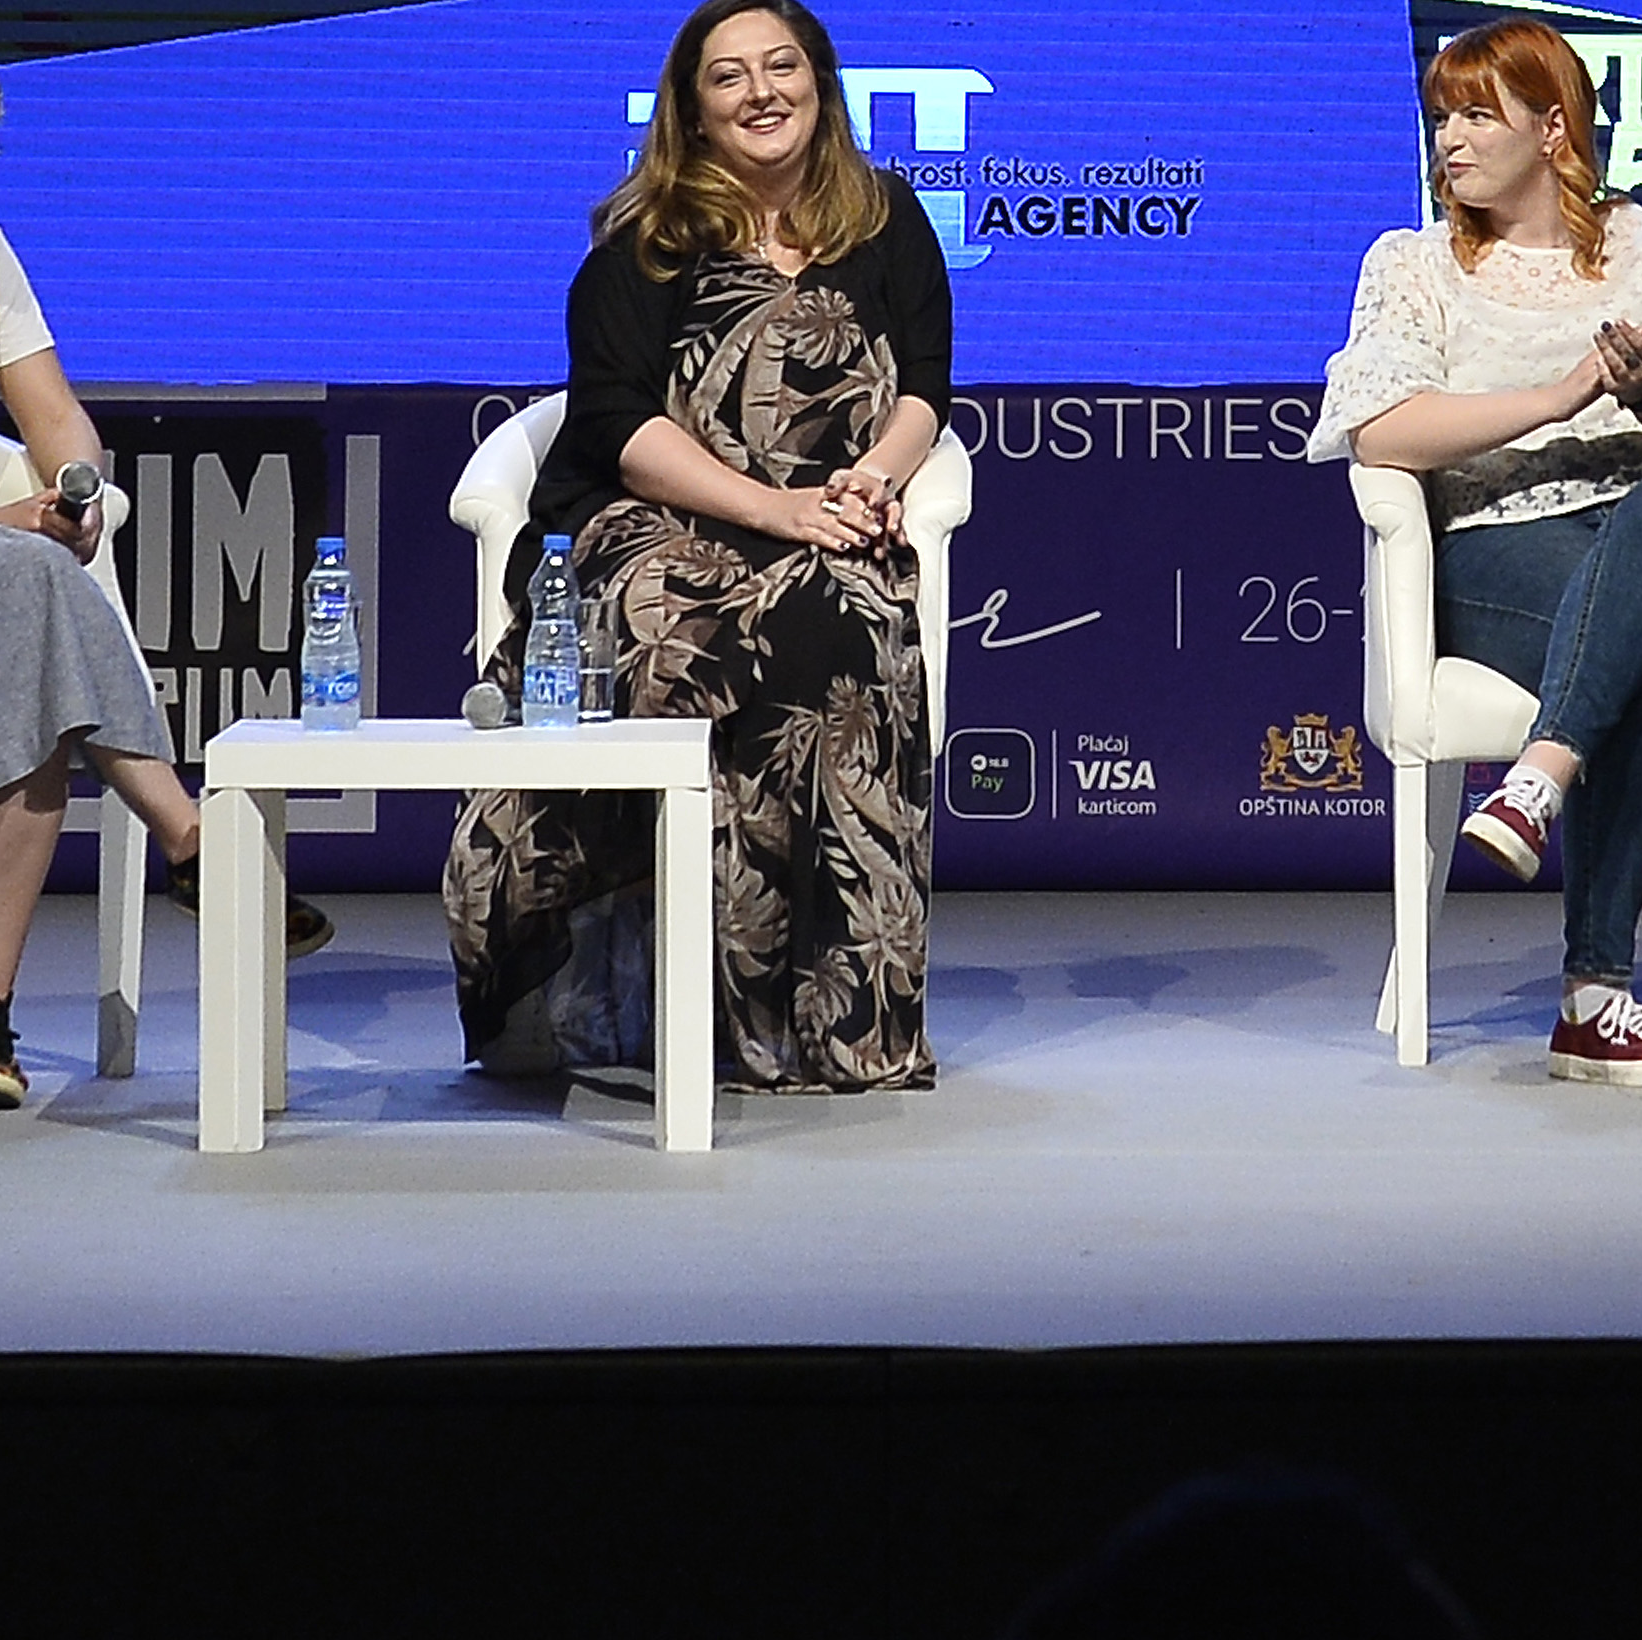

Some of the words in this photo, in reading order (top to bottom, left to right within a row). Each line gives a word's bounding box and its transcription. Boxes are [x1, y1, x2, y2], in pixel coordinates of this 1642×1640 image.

[981, 157, 1071, 185] fokus.
[1084, 159, 1203, 185] rezultati
[979, 195, 1199, 236] AGENCY
[951, 397, 1312, 460] DUSTRIES
[107, 452, 295, 652] IM
[971, 774, 1004, 793] Pay
[1069, 760, 1156, 791] VISA
[1077, 797, 1156, 815] karticom
[1239, 796, 1321, 816] OPŠTINA
[1324, 799, 1386, 816] KOTOR
